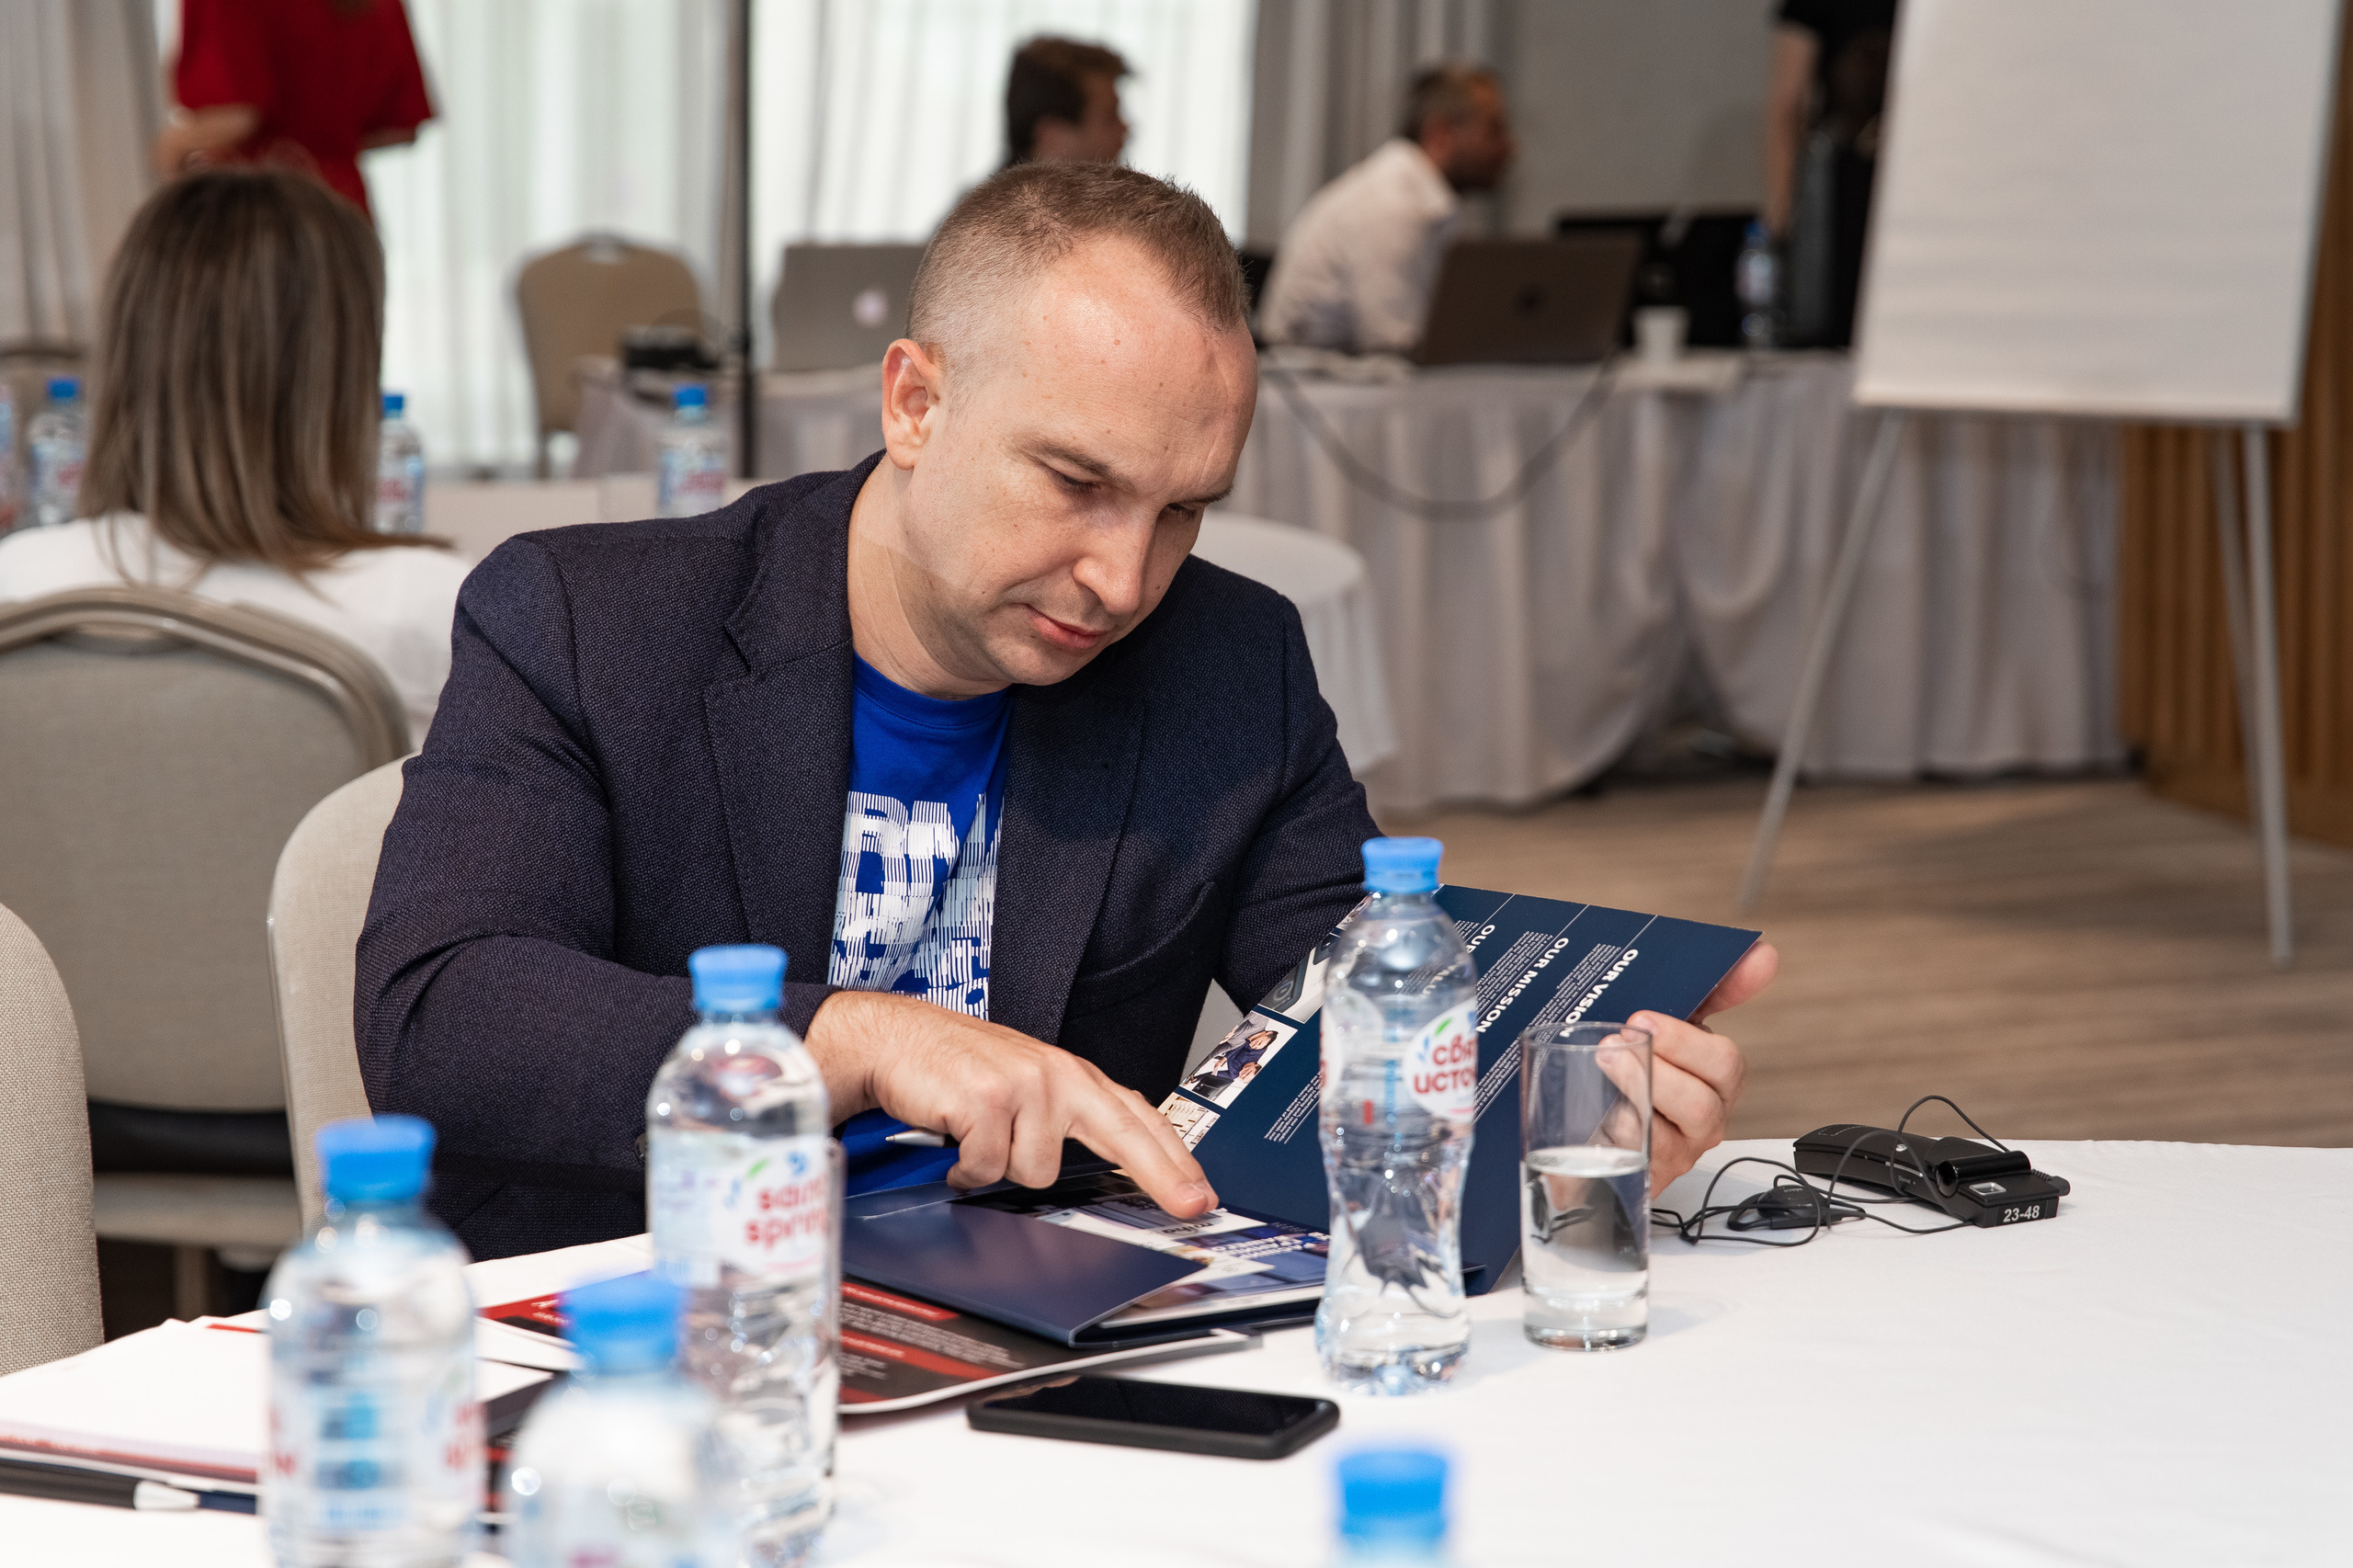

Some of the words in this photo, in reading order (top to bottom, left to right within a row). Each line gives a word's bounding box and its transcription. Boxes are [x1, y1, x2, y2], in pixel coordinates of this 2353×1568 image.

[1534, 937, 1569, 969] OUR
[1602, 949, 1639, 982] OUR
[1475, 971, 1539, 1033] MISSION
[1559, 983, 1608, 1039] VISION
[2003, 1205, 2040, 1222] 23-48
